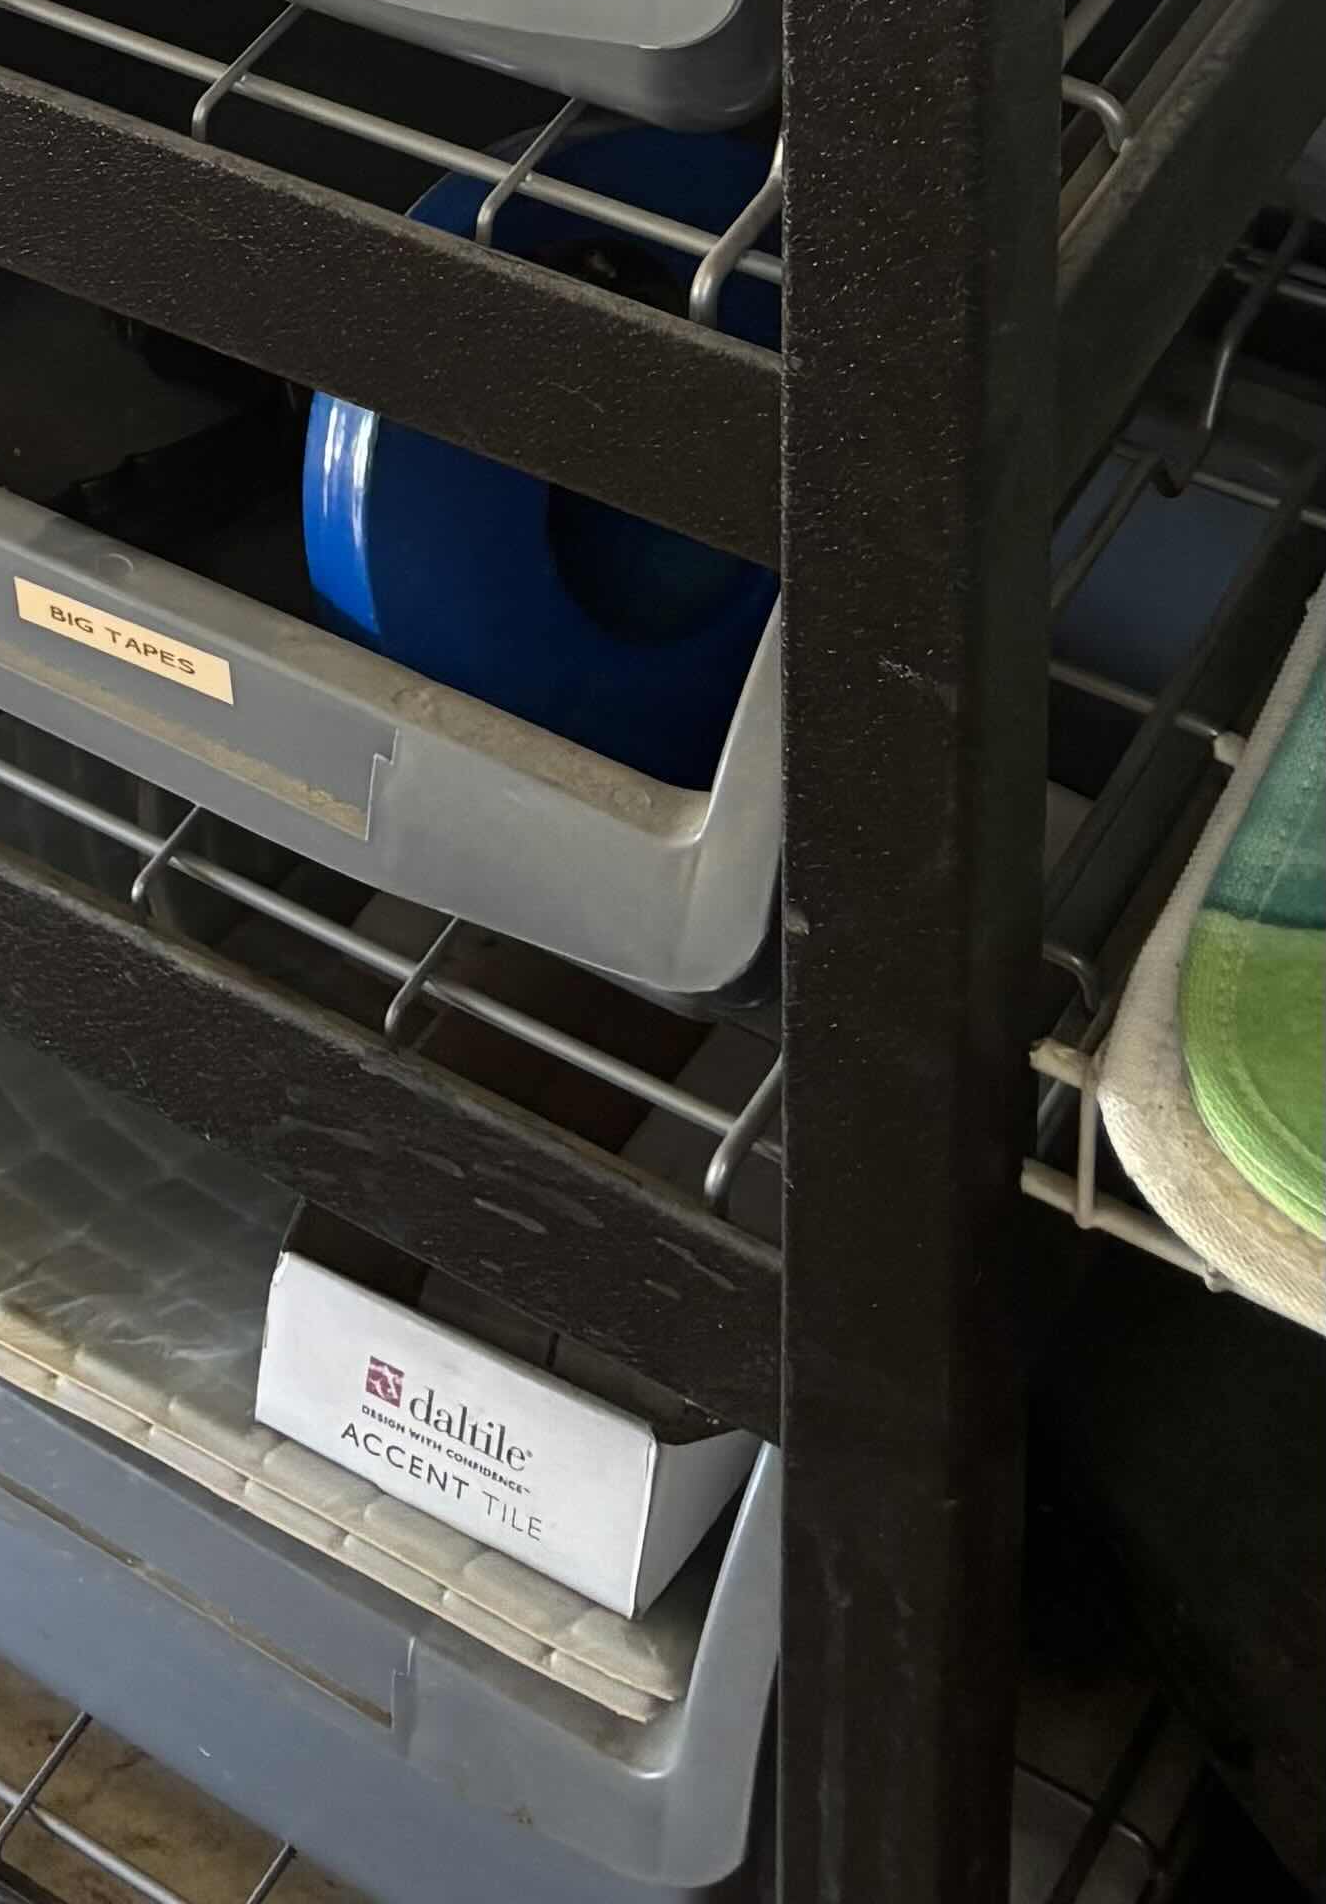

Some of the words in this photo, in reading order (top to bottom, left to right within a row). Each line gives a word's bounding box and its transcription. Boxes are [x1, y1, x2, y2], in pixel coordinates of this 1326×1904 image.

[49, 605, 94, 634] BIG
[104, 626, 196, 676] TAPES
[361, 1404, 406, 1434] DESIGN
[409, 1427, 443, 1453] WITH
[340, 1422, 470, 1500] ACCENT
[482, 1489, 542, 1542] TILE
